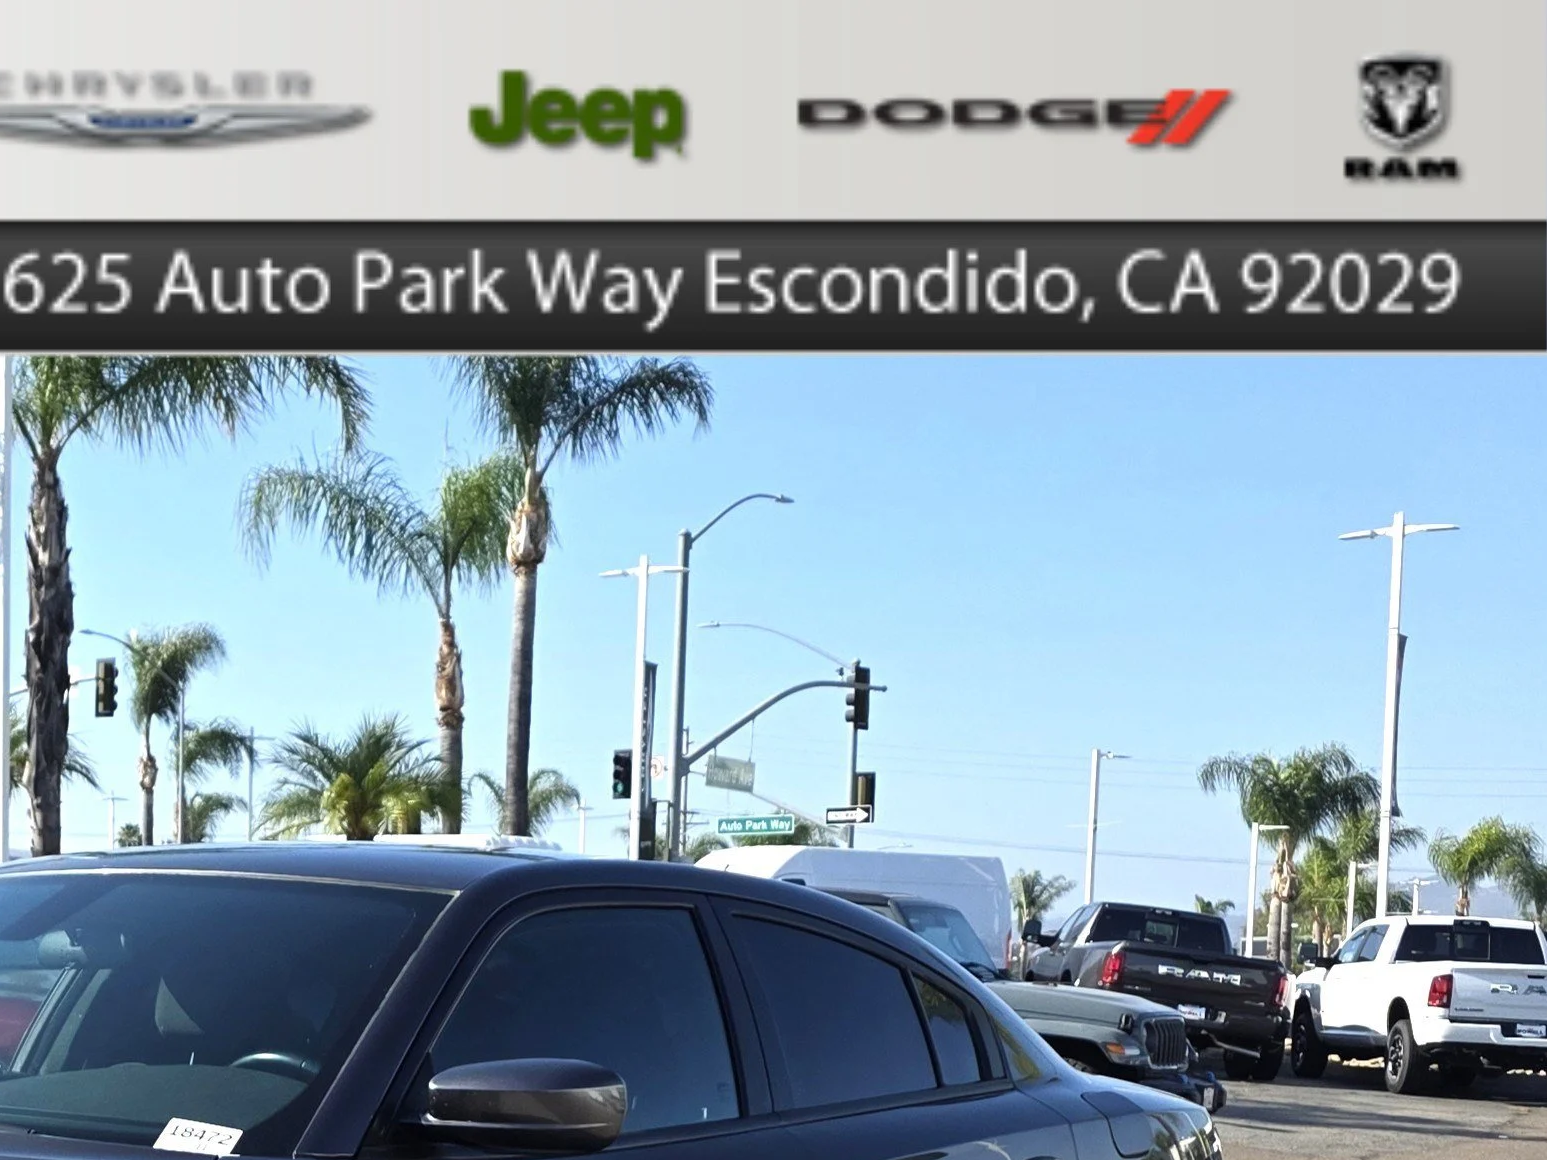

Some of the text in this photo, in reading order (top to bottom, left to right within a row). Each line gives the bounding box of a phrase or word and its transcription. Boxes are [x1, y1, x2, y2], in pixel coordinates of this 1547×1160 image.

[719, 819, 791, 832] Auto Park Way
[1158, 964, 1241, 986] RAM
[170, 1125, 232, 1146] 18472
